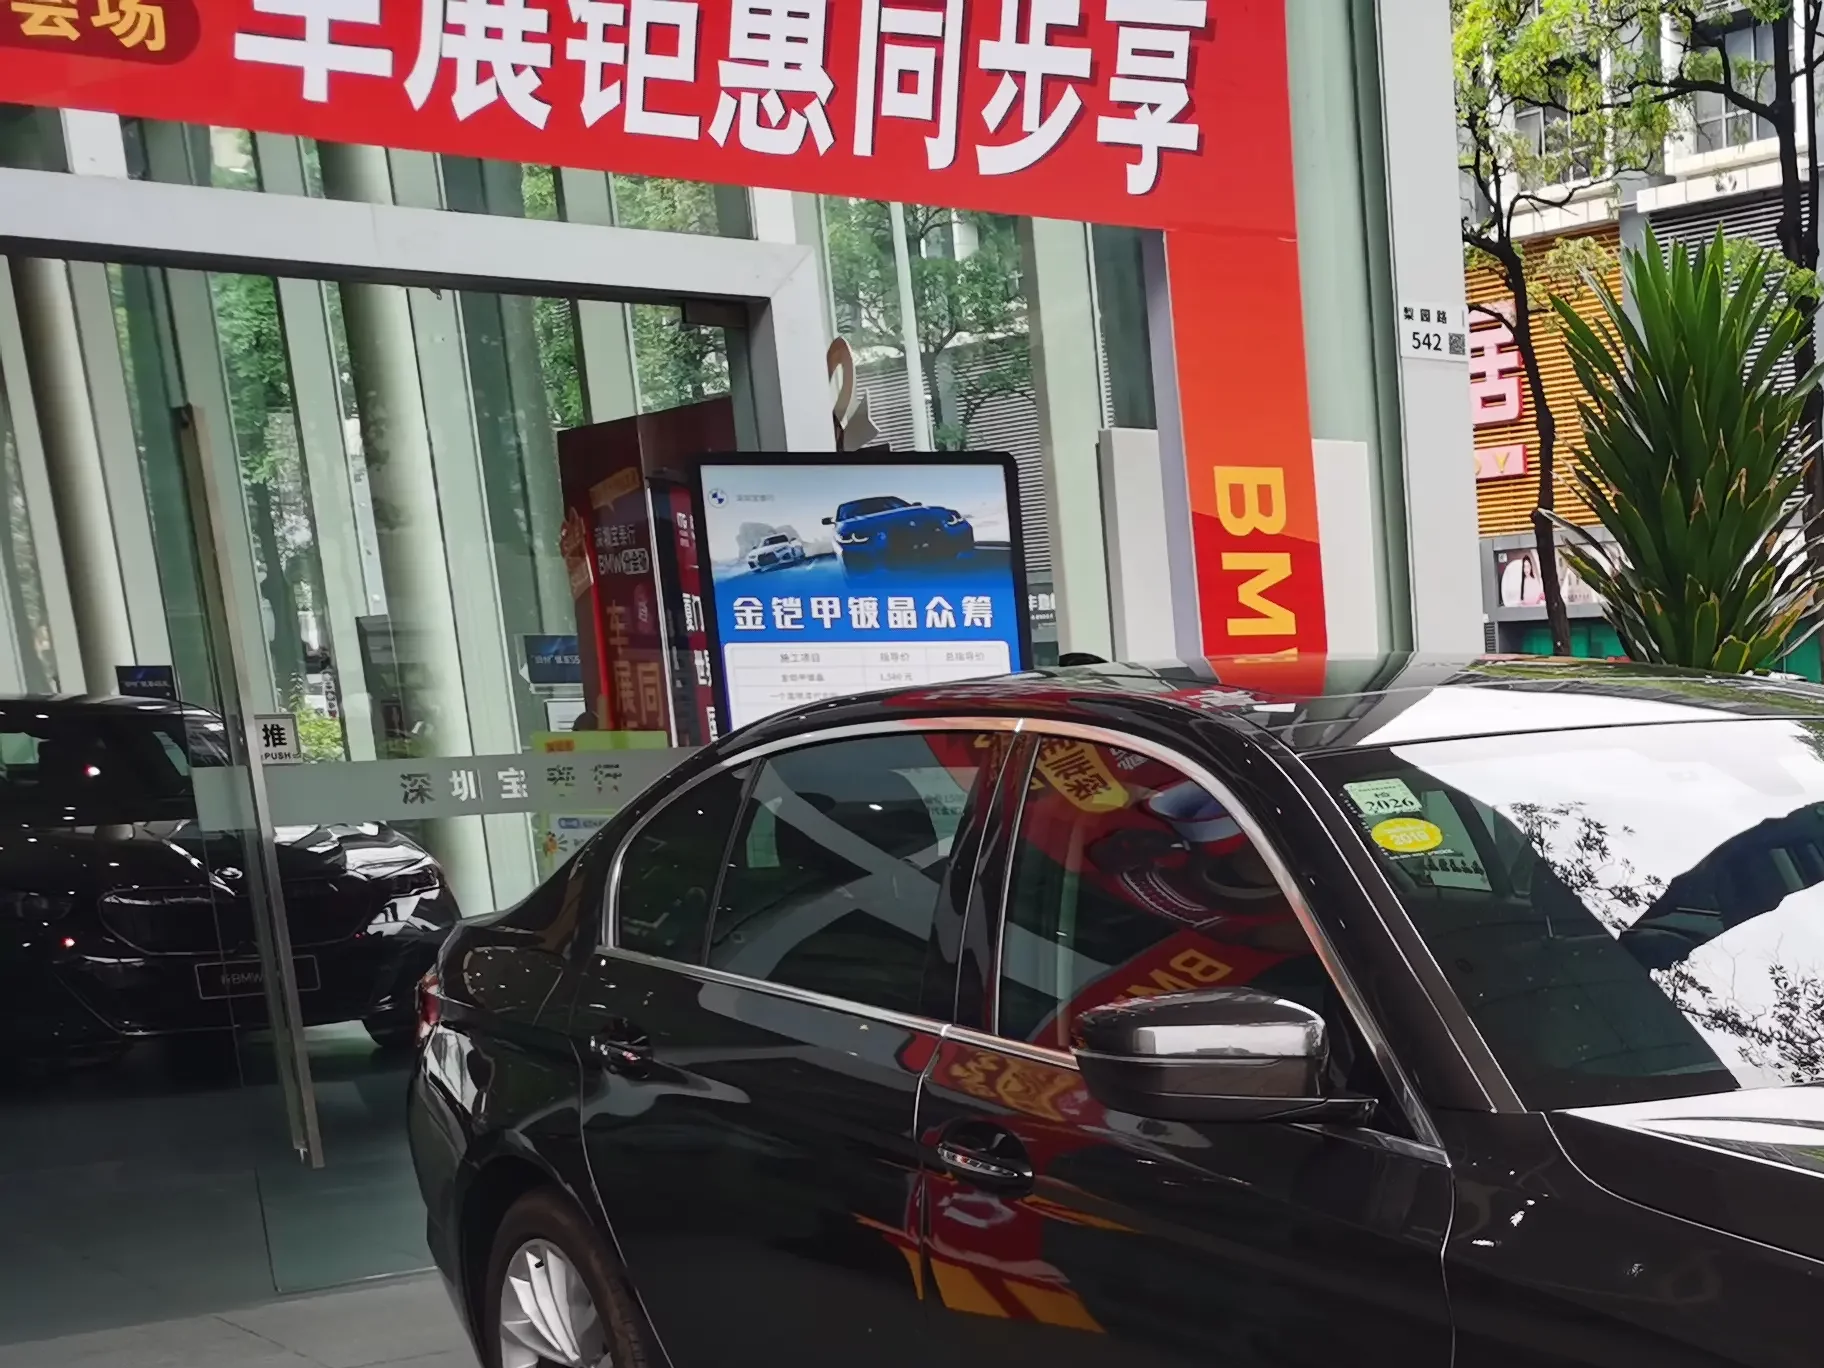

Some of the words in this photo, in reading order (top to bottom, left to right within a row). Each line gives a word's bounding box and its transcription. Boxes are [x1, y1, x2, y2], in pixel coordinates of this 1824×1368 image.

[1403, 306, 1447, 325] 梨园路
[1412, 332, 1442, 351] 542
[1213, 466, 1298, 664] BM
[732, 596, 993, 630] 金铠甲镀晶众筹
[262, 723, 288, 748] 推
[264, 752, 292, 761] PUSH
